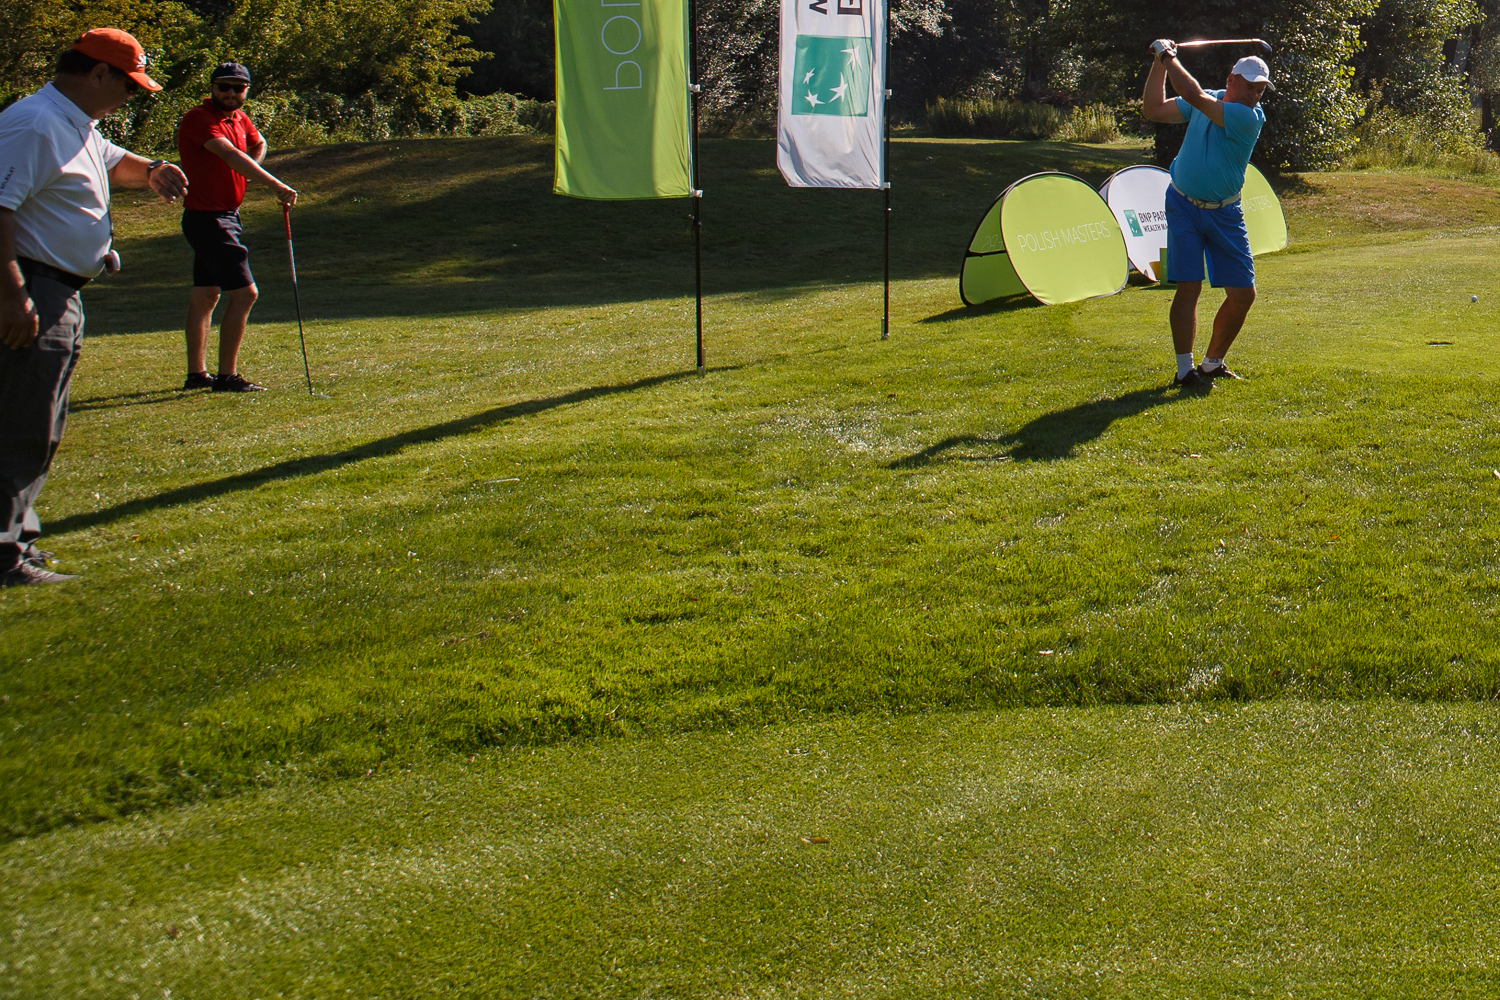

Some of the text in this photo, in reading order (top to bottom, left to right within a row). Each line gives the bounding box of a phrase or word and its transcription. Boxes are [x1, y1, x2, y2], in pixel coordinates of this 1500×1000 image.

[1138, 211, 1152, 223] BNP
[1143, 223, 1161, 233] WEALTH
[1017, 230, 1062, 253] POLISH
[1060, 221, 1111, 245] MASTERS
